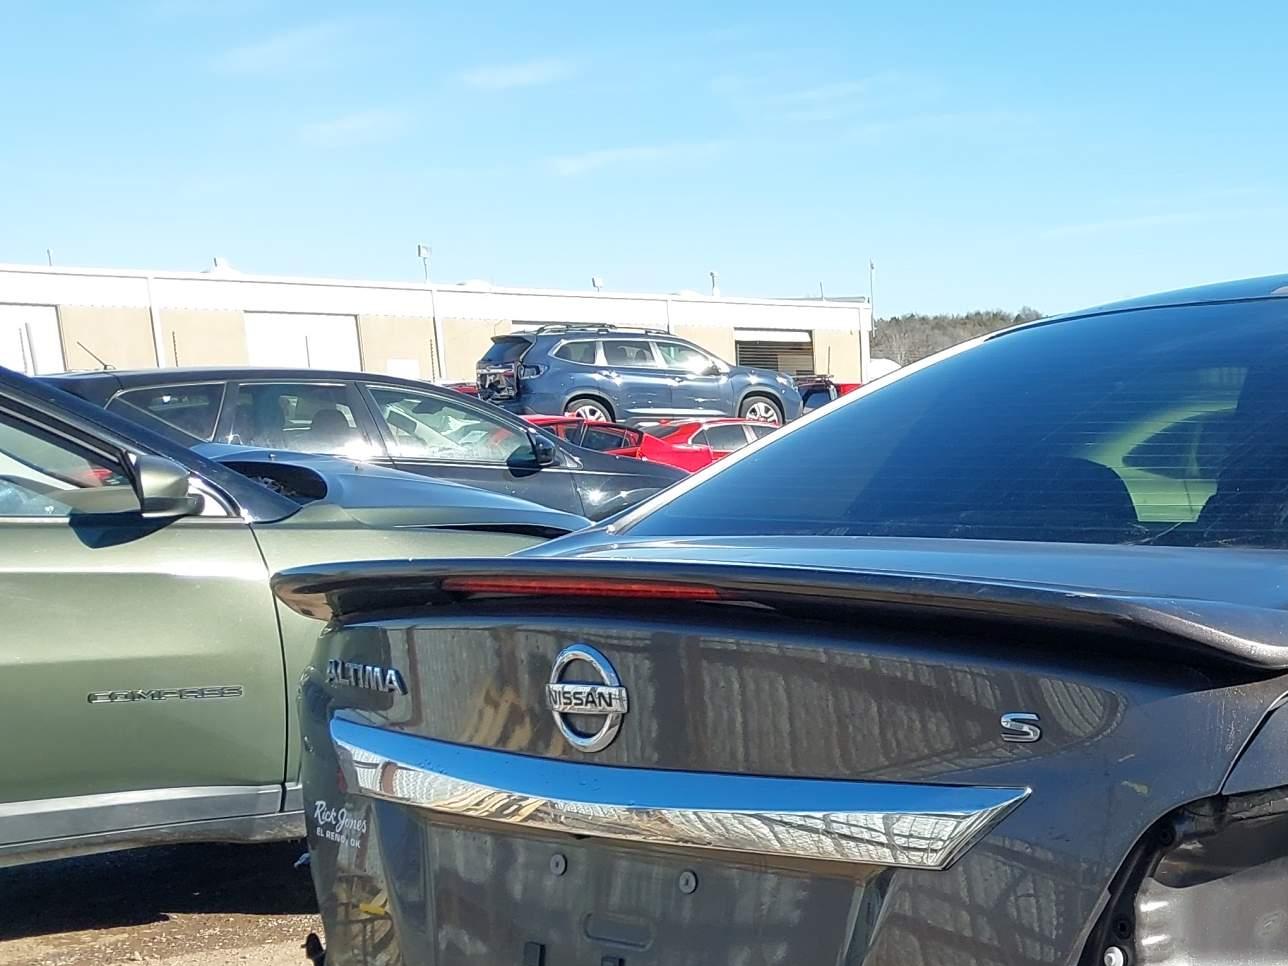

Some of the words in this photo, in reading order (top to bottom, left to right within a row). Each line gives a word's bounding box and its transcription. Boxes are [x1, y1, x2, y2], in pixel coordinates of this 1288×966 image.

[326, 659, 406, 696] ALTIMA
[550, 687, 613, 708] NISSAN
[1000, 712, 1041, 742] S
[314, 800, 336, 825] Rick
[336, 808, 367, 833] Jones
